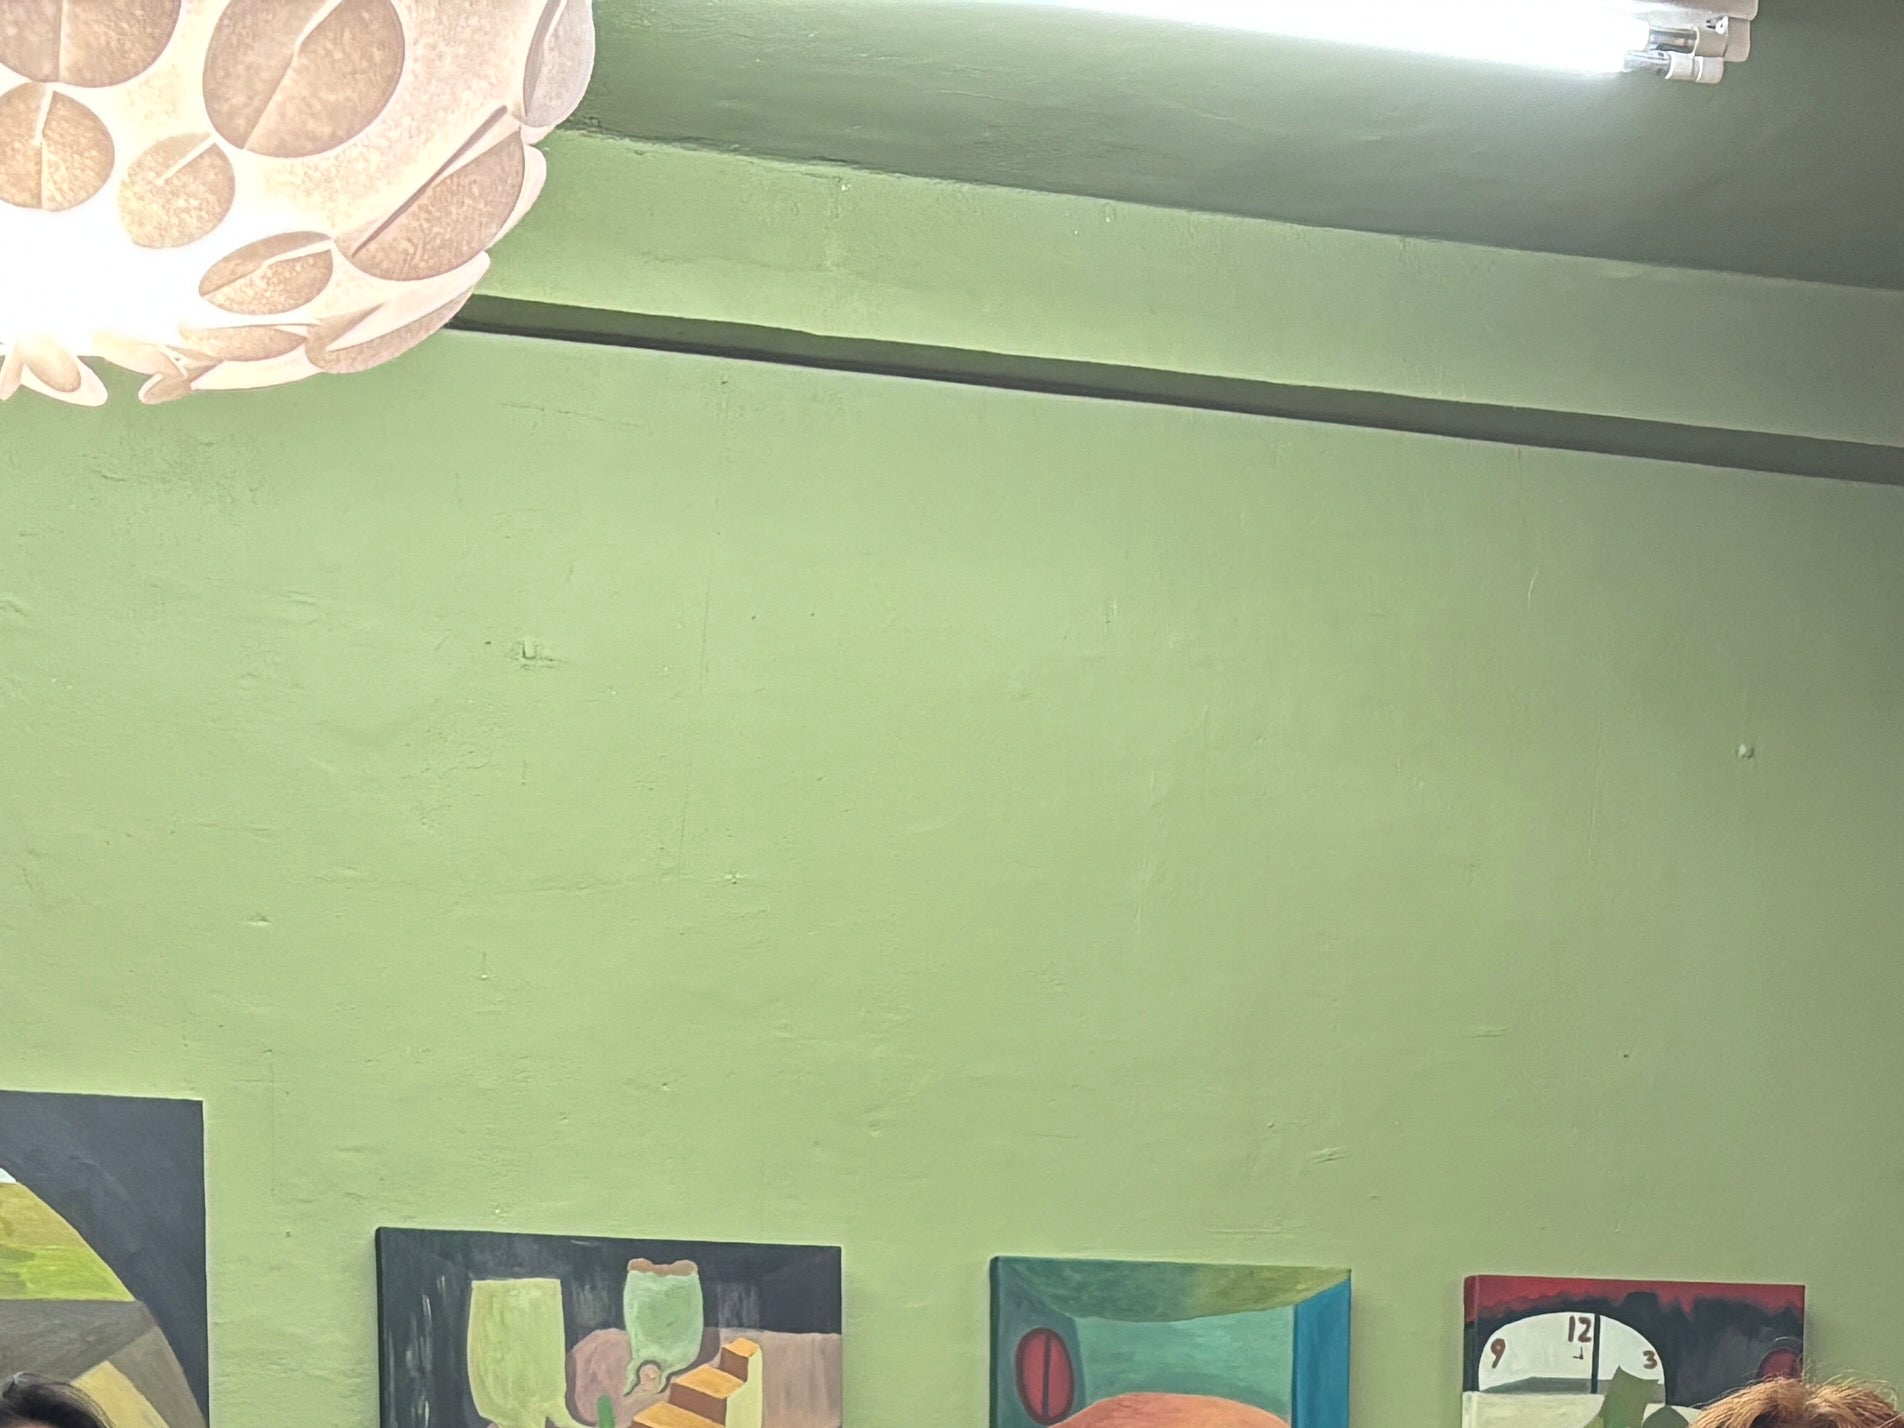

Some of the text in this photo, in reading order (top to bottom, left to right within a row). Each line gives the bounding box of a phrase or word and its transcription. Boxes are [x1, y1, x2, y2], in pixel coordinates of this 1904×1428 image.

[1567, 1315, 1592, 1343] 12
[1490, 1337, 1506, 1369] 9
[1642, 1350, 1658, 1370] 3
